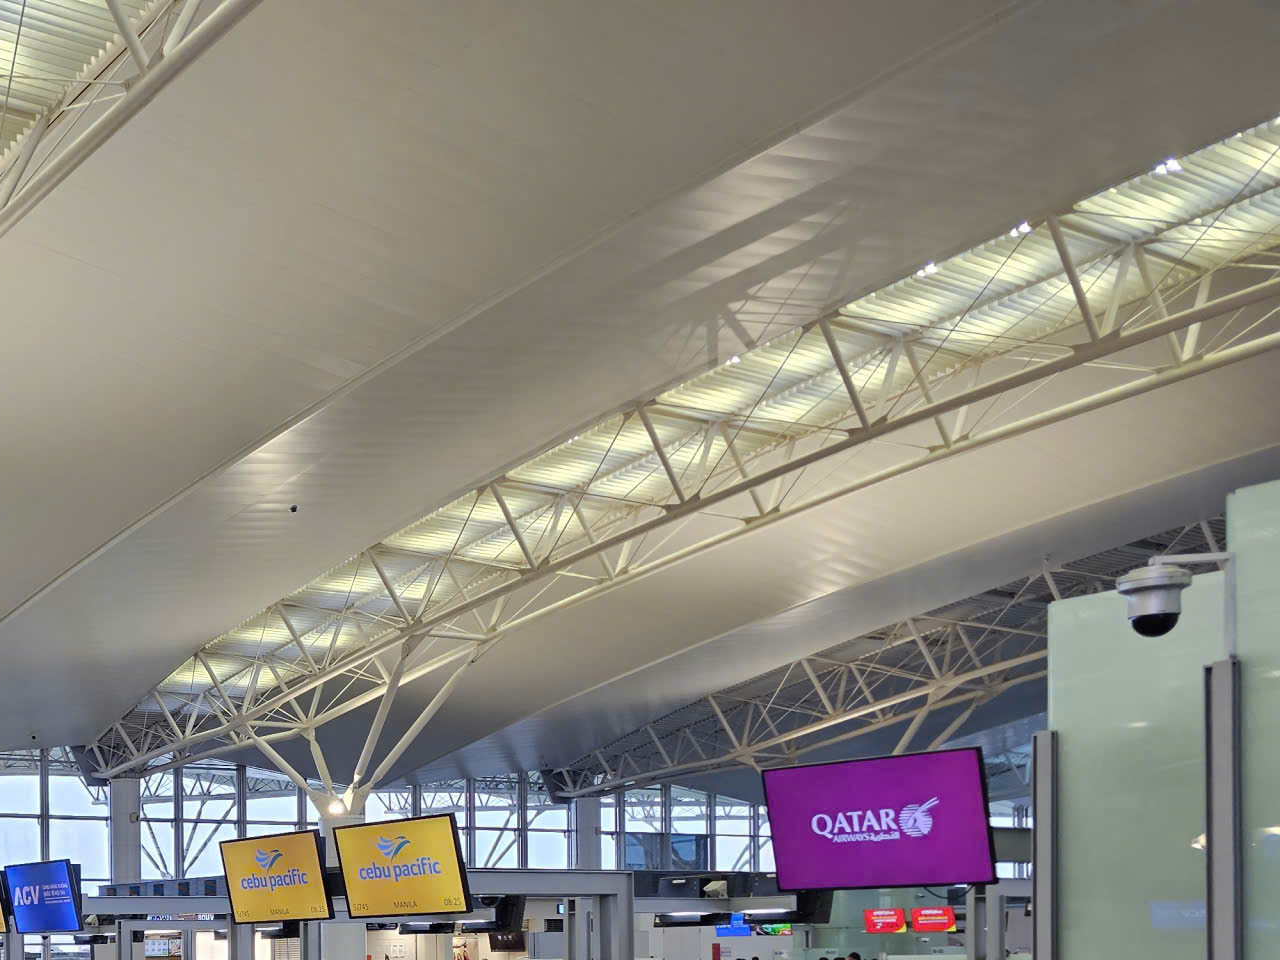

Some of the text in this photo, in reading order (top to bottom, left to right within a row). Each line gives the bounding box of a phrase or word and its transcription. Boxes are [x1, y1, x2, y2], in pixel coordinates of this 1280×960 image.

[811, 808, 898, 839] QATAR
[832, 832, 873, 843] AIRWAYS
[241, 868, 309, 891] cebu pacific
[359, 856, 441, 883] cebu pacific
[14, 885, 39, 906] ACV
[393, 900, 418, 908] MANILA
